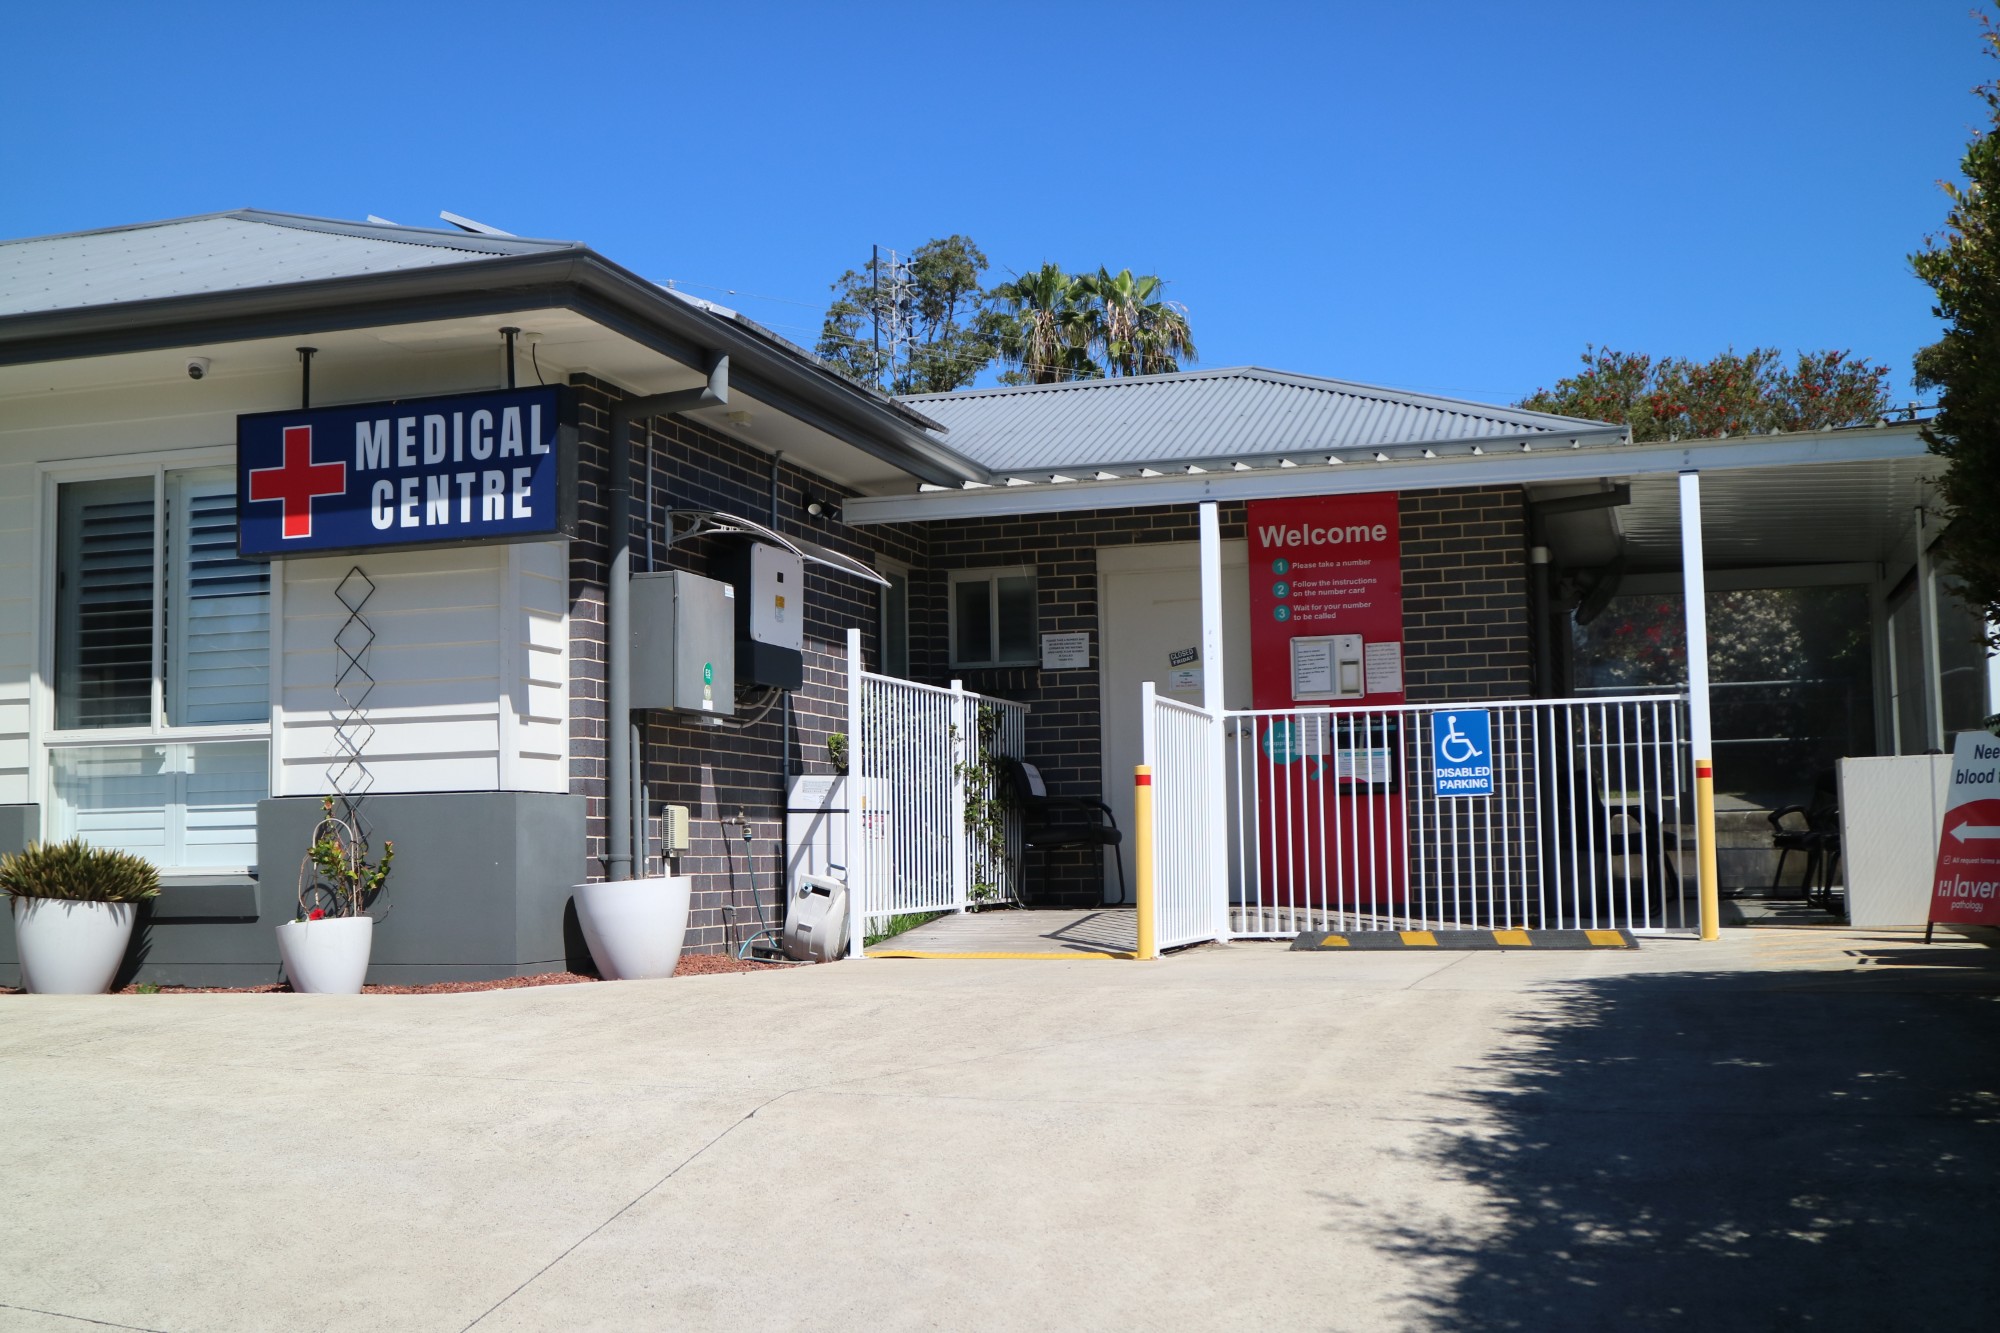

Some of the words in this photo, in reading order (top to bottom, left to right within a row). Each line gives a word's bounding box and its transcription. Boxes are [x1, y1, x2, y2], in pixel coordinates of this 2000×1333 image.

[356, 404, 549, 471] MEDICAL
[371, 467, 532, 530] CENTRE
[1258, 523, 1388, 548] Welcome
[1277, 562, 1284, 572] 1
[1292, 562, 1317, 570] Please
[1342, 559, 1371, 567] number
[1277, 585, 1285, 595] 2
[1292, 580, 1317, 588] Follow
[1319, 579, 1331, 587] the
[1332, 577, 1377, 586] instructions
[1318, 588, 1346, 596] number
[1278, 608, 1286, 619] 3
[1293, 604, 1310, 612] Wait
[1311, 603, 1322, 611] for
[1323, 603, 1341, 612] your
[1342, 601, 1372, 609] number
[1314, 612, 1337, 620] called
[1170, 648, 1194, 660] CLOSED
[1172, 655, 1194, 666] FRIDAY
[1436, 766, 1490, 778] DISABLED
[1955, 767, 1996, 785] blood
[1439, 778, 1488, 790] PARKING
[1960, 857, 1980, 866] request
[1953, 873, 2000, 899] laver
[1950, 900, 1984, 913] pathology
